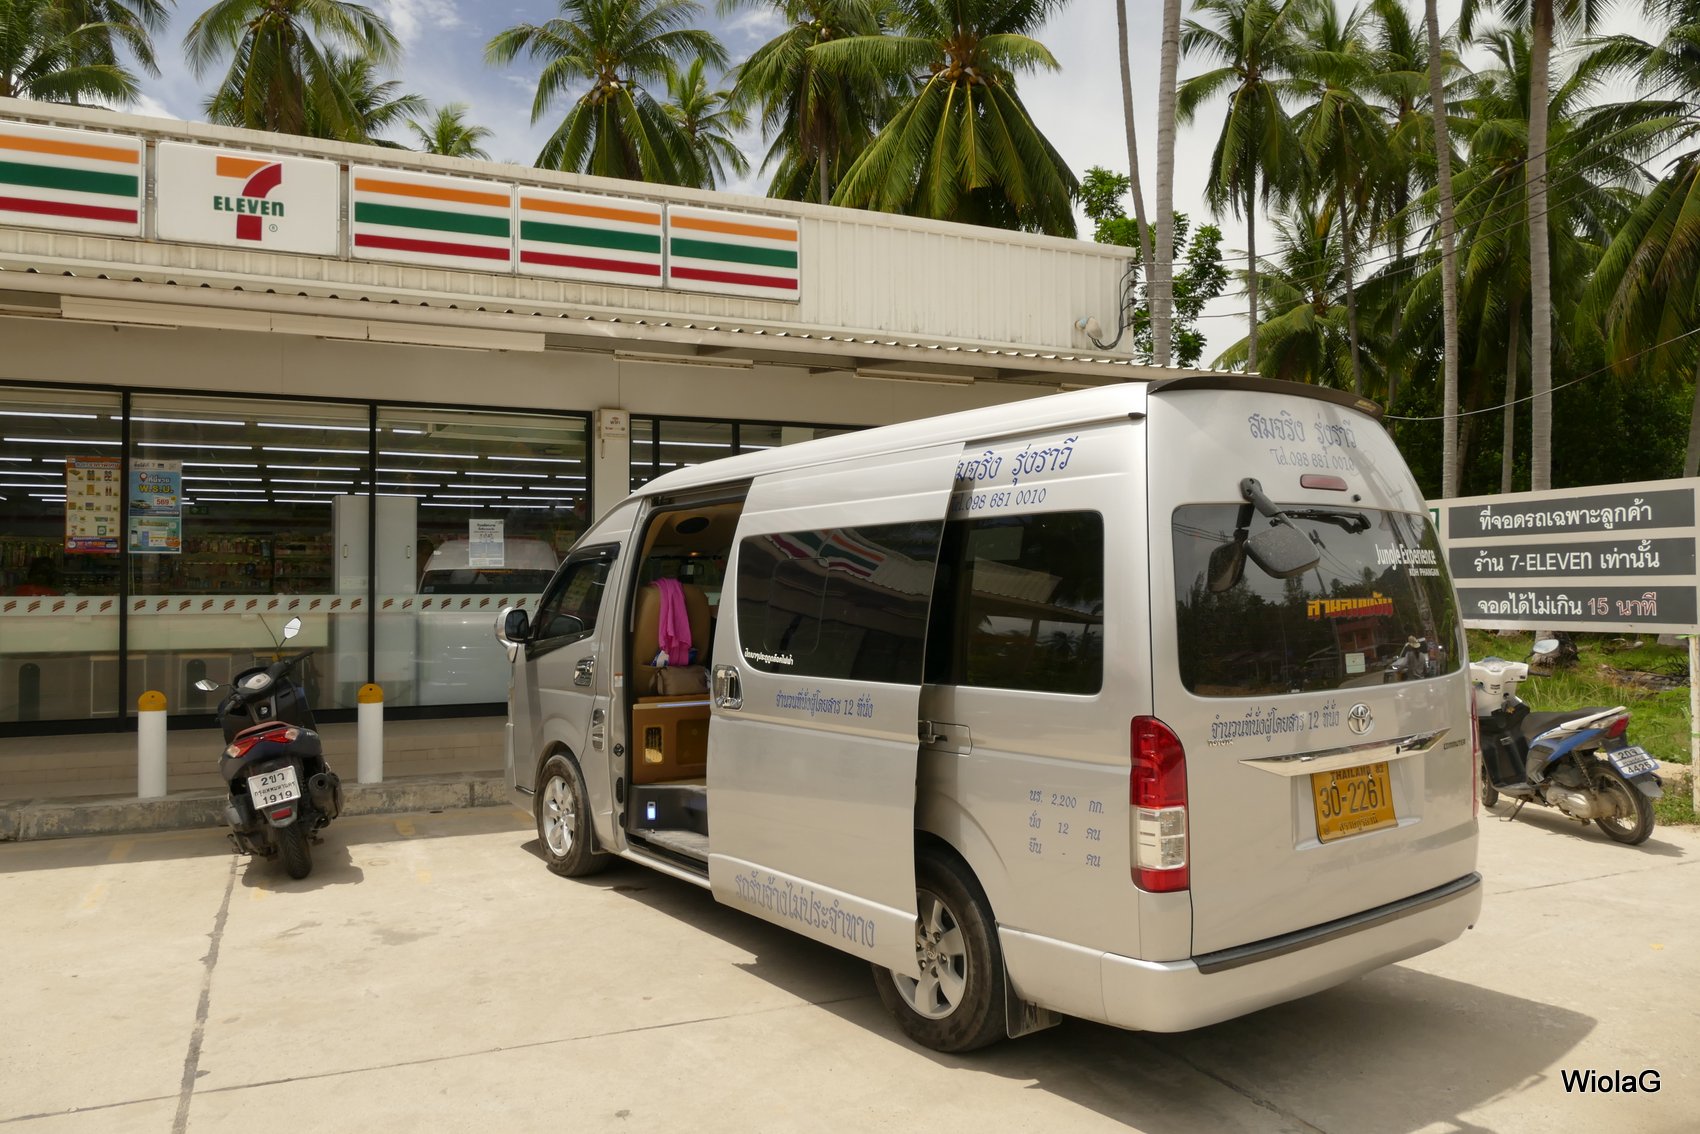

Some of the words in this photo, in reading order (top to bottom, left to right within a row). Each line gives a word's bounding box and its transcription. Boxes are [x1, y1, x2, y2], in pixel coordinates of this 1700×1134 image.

[954, 450, 1002, 482] มจริง
[989, 491, 1012, 508] 681
[1015, 487, 1047, 506] 0010
[1479, 497, 1653, 530] ที่จอดรถเฉพาะลูกค้า
[1375, 543, 1402, 571] Jungle
[1473, 550, 1504, 572] ร้าน
[1600, 539, 1660, 569] เท่านั้น
[1477, 592, 1582, 616] จอดได้ไม่เกิน
[1587, 597, 1609, 615] 15
[1616, 591, 1657, 617] นาที
[843, 699, 855, 716] 12
[1211, 706, 1305, 743] จำนวนที่นั่งผู้โดยสาร
[1308, 710, 1319, 730] 12
[262, 790, 293, 805] 1919
[1319, 777, 1386, 819] 30-2261
[1058, 822, 1069, 835] 12
